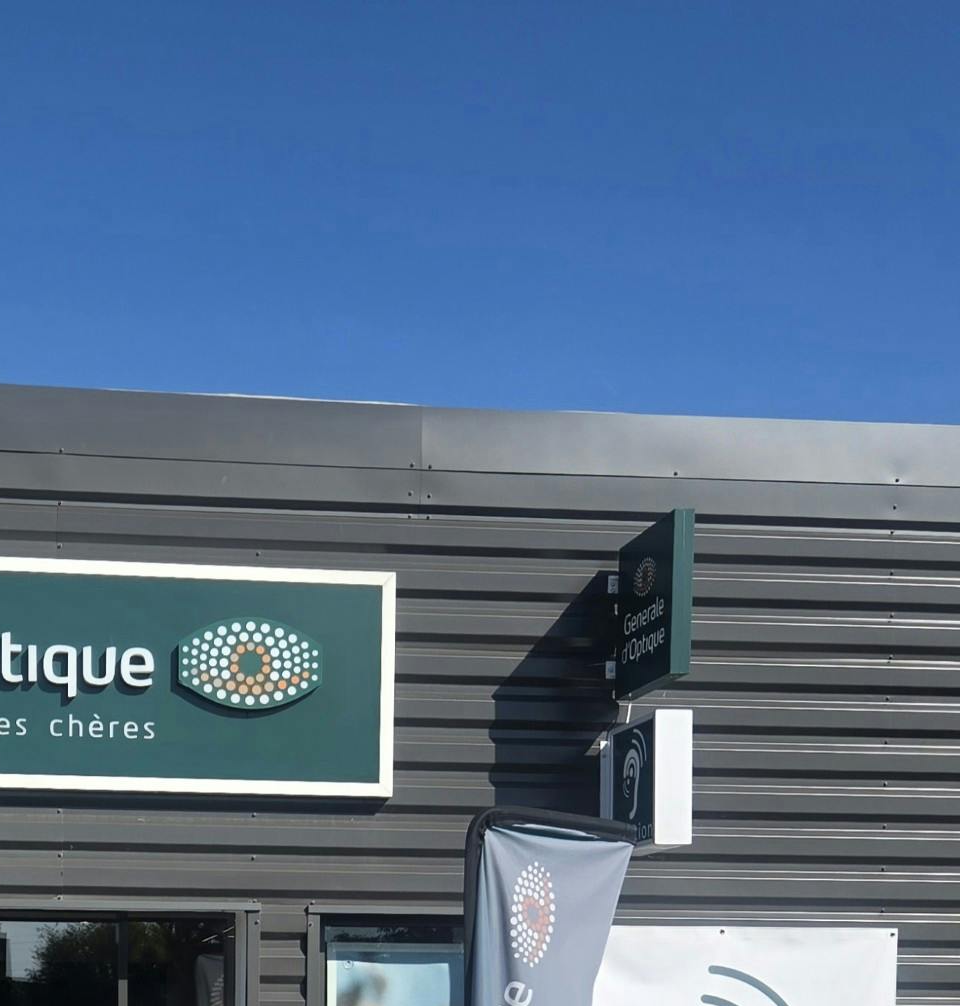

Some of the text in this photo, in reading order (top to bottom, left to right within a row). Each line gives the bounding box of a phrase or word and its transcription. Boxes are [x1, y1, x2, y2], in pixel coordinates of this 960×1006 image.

[623, 596, 665, 635] Generale
[622, 627, 665, 665] d'Optique
[49, 713, 156, 740] chères
